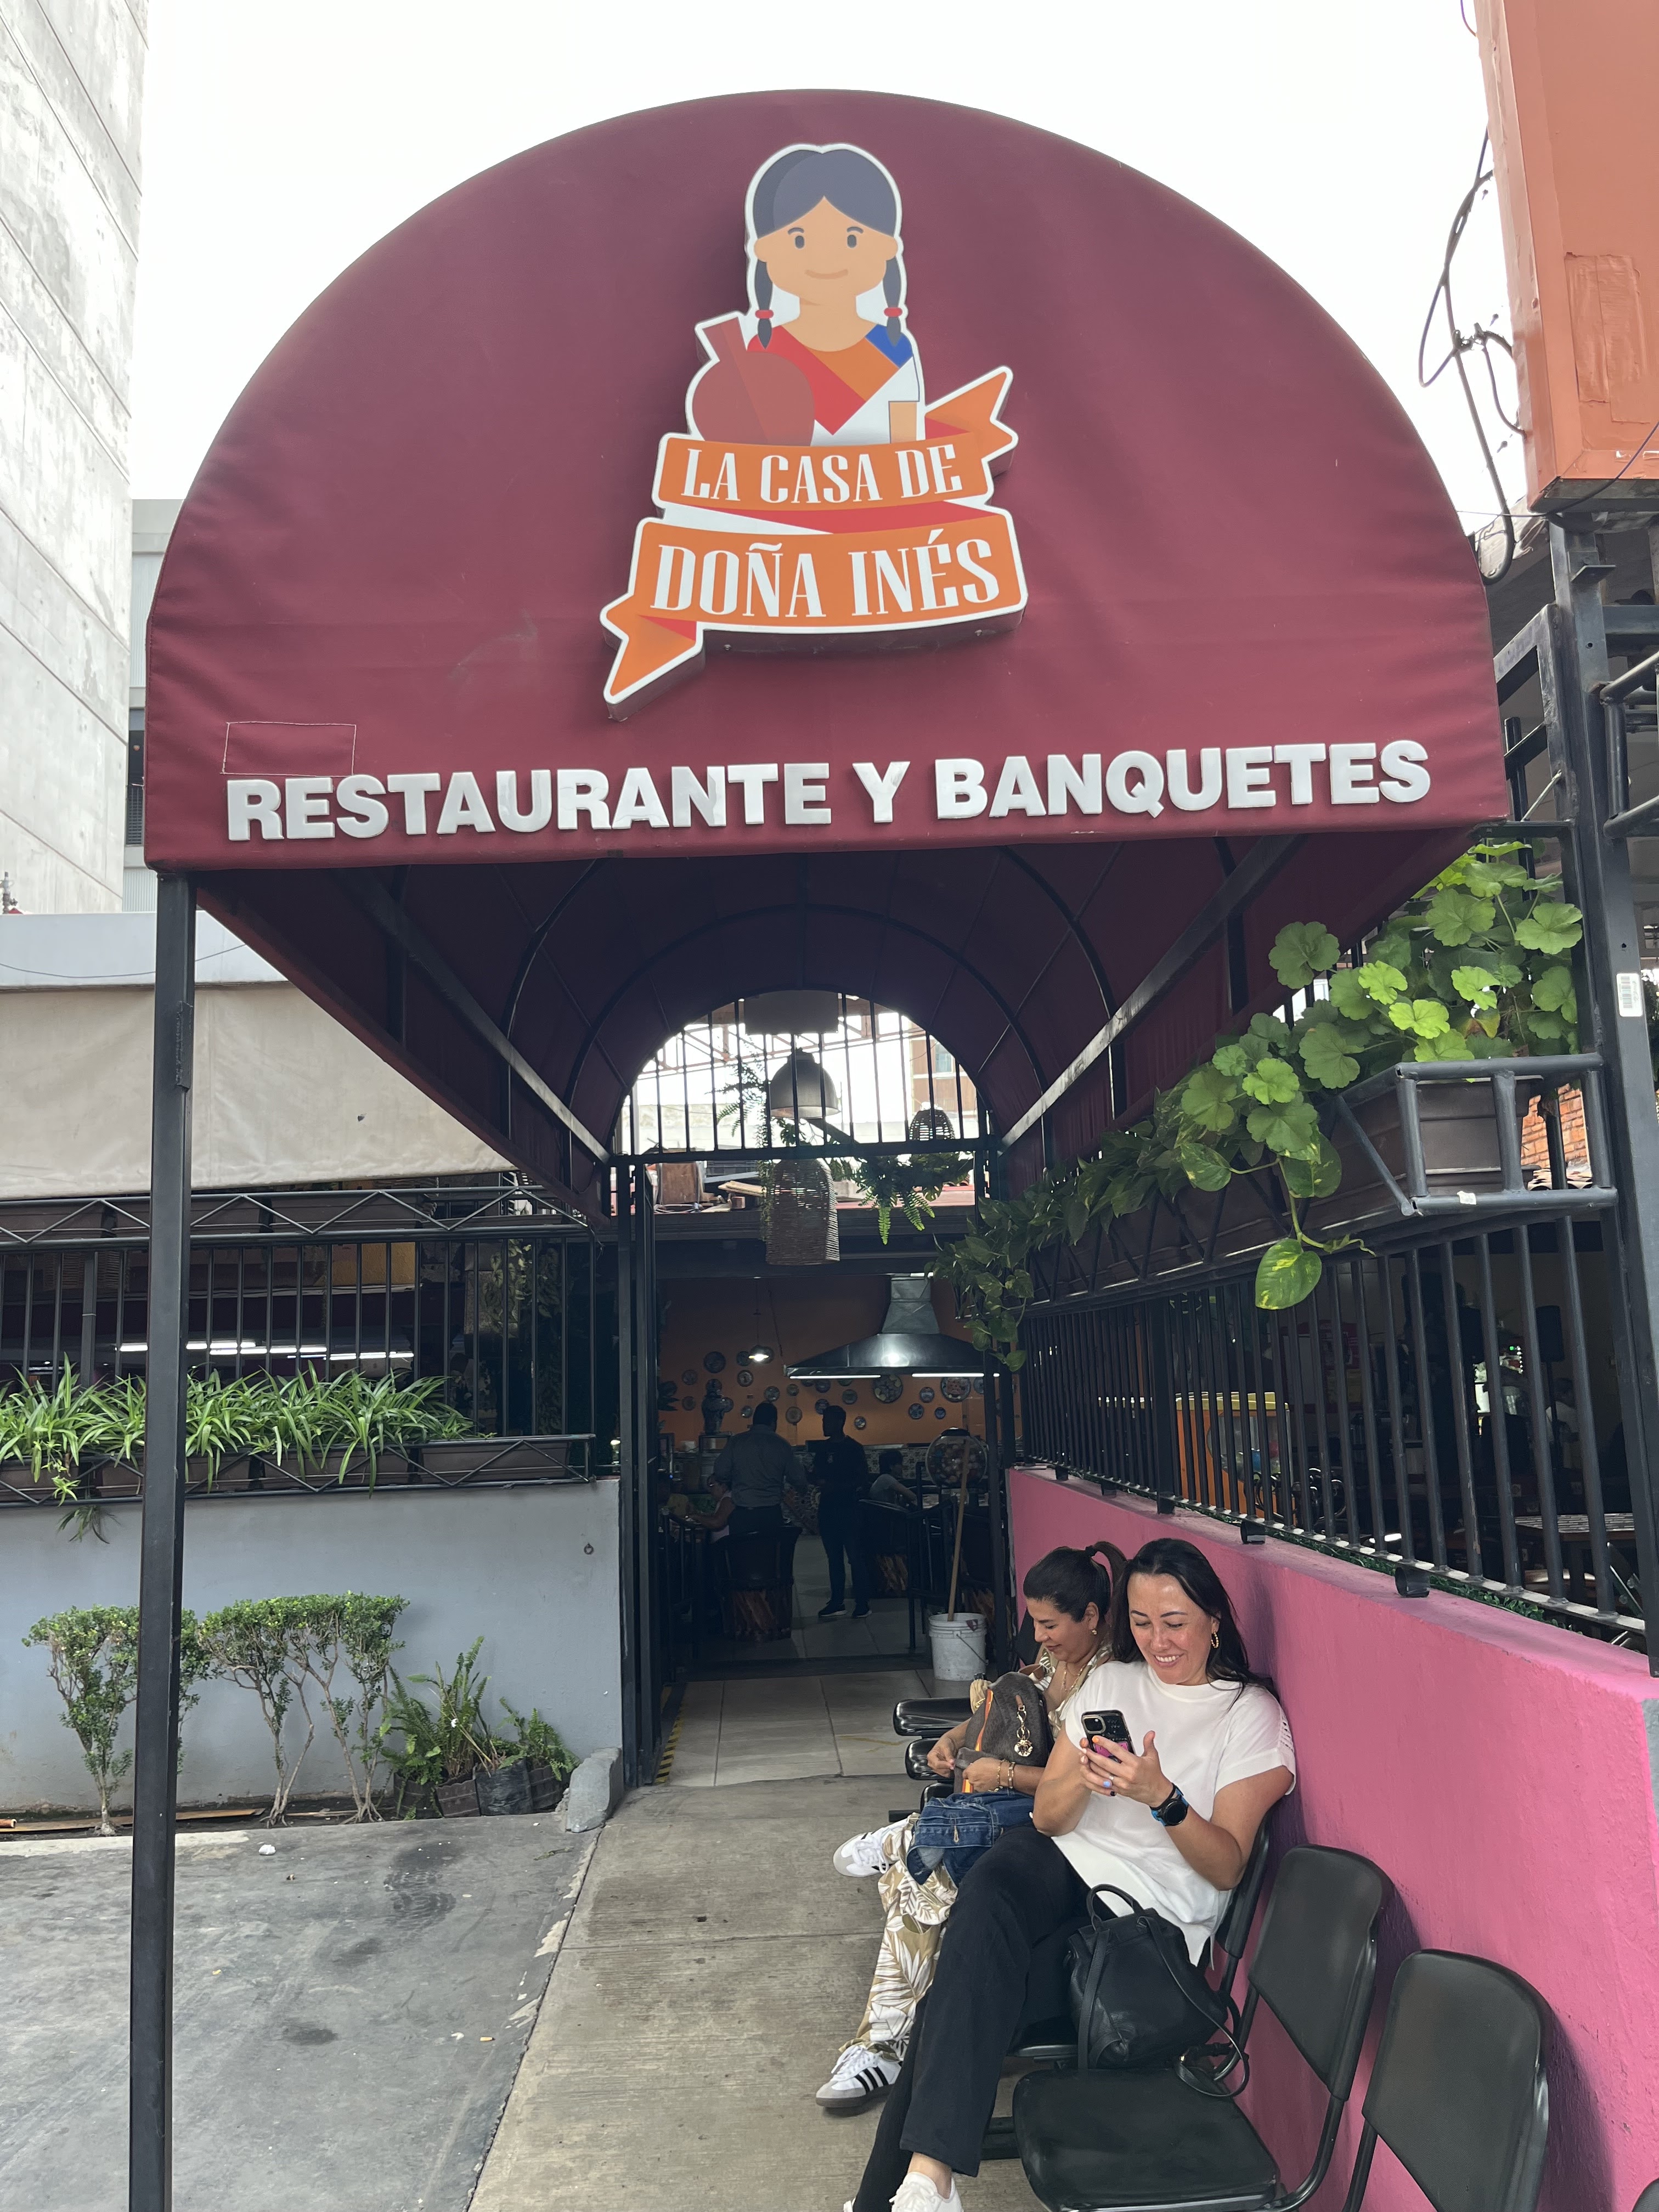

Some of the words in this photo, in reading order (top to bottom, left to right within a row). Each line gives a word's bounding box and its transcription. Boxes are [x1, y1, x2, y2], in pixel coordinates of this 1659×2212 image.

[681, 448, 740, 501] LA
[760, 453, 883, 503] CASA
[895, 444, 962, 498] DE
[650, 542, 826, 617] DOÑA
[848, 529, 1000, 616] INÉS
[227, 763, 831, 840] RESTAURANTE
[853, 761, 910, 823] Y
[935, 740, 1431, 819] BANQUETES
